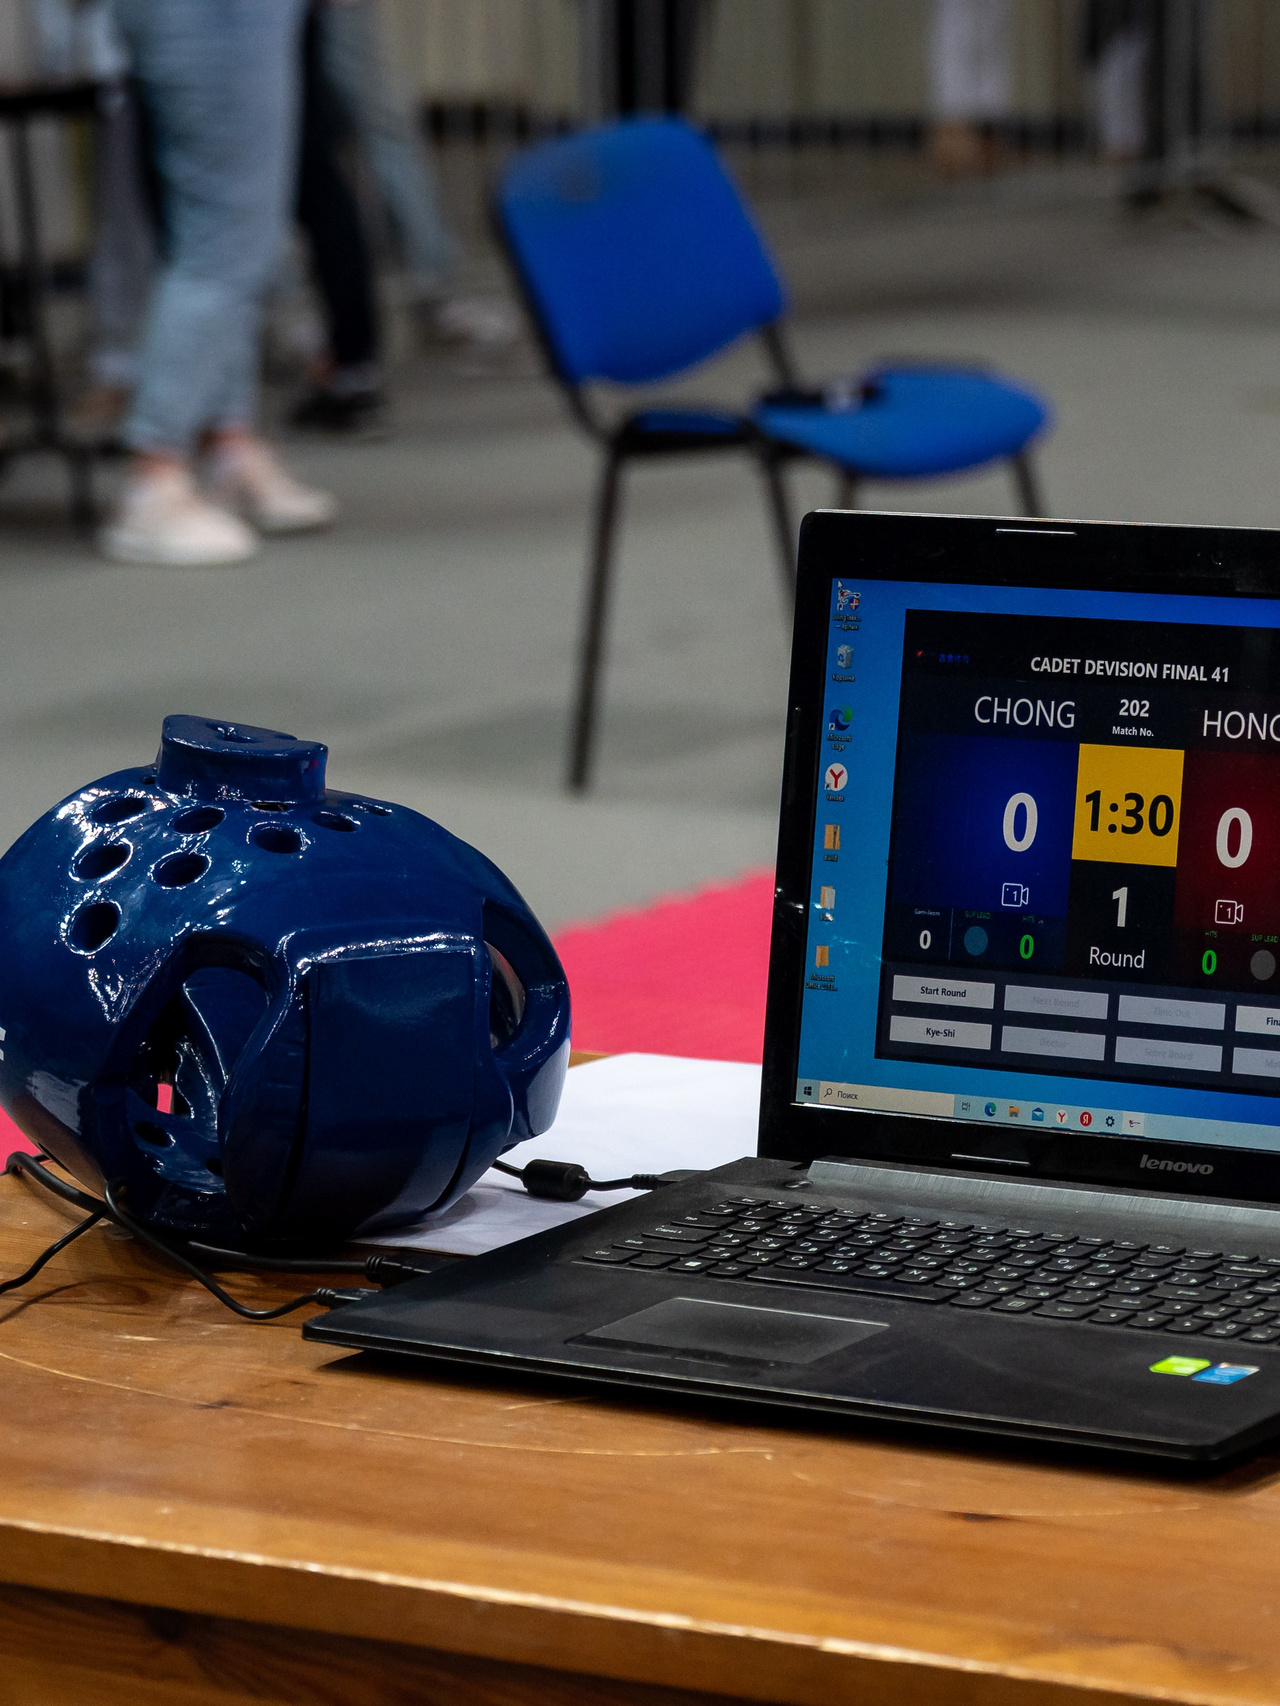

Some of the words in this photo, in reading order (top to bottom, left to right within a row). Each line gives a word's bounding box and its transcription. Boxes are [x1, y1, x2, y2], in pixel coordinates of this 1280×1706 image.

[1030, 656, 1080, 674] CADET
[1085, 659, 1158, 679] DEVISION
[1162, 663, 1207, 682] FINAL
[1211, 666, 1230, 683] 41
[974, 695, 1076, 729] CHONG
[1119, 699, 1150, 717] 202
[1112, 725, 1137, 737] Match
[1139, 727, 1154, 738] No.
[1002, 792, 1038, 853] 0
[1085, 789, 1174, 837] 1:30
[1215, 807, 1253, 869] 0
[1111, 886, 1128, 928] 1
[919, 929, 932, 950] 0
[1019, 933, 1034, 960] 0
[1088, 946, 1145, 969] Round
[1201, 949, 1218, 976] 0
[920, 984, 940, 997] Start
[942, 986, 967, 999] Round
[1031, 995, 1053, 1007] Next
[1055, 997, 1080, 1010] Round
[1152, 1006, 1175, 1018] Time
[1177, 1008, 1191, 1020] Out
[925, 1026, 956, 1039] Kye-Shi
[837, 1088, 859, 1101] Поиск
[1139, 1154, 1214, 1175] lenovo
